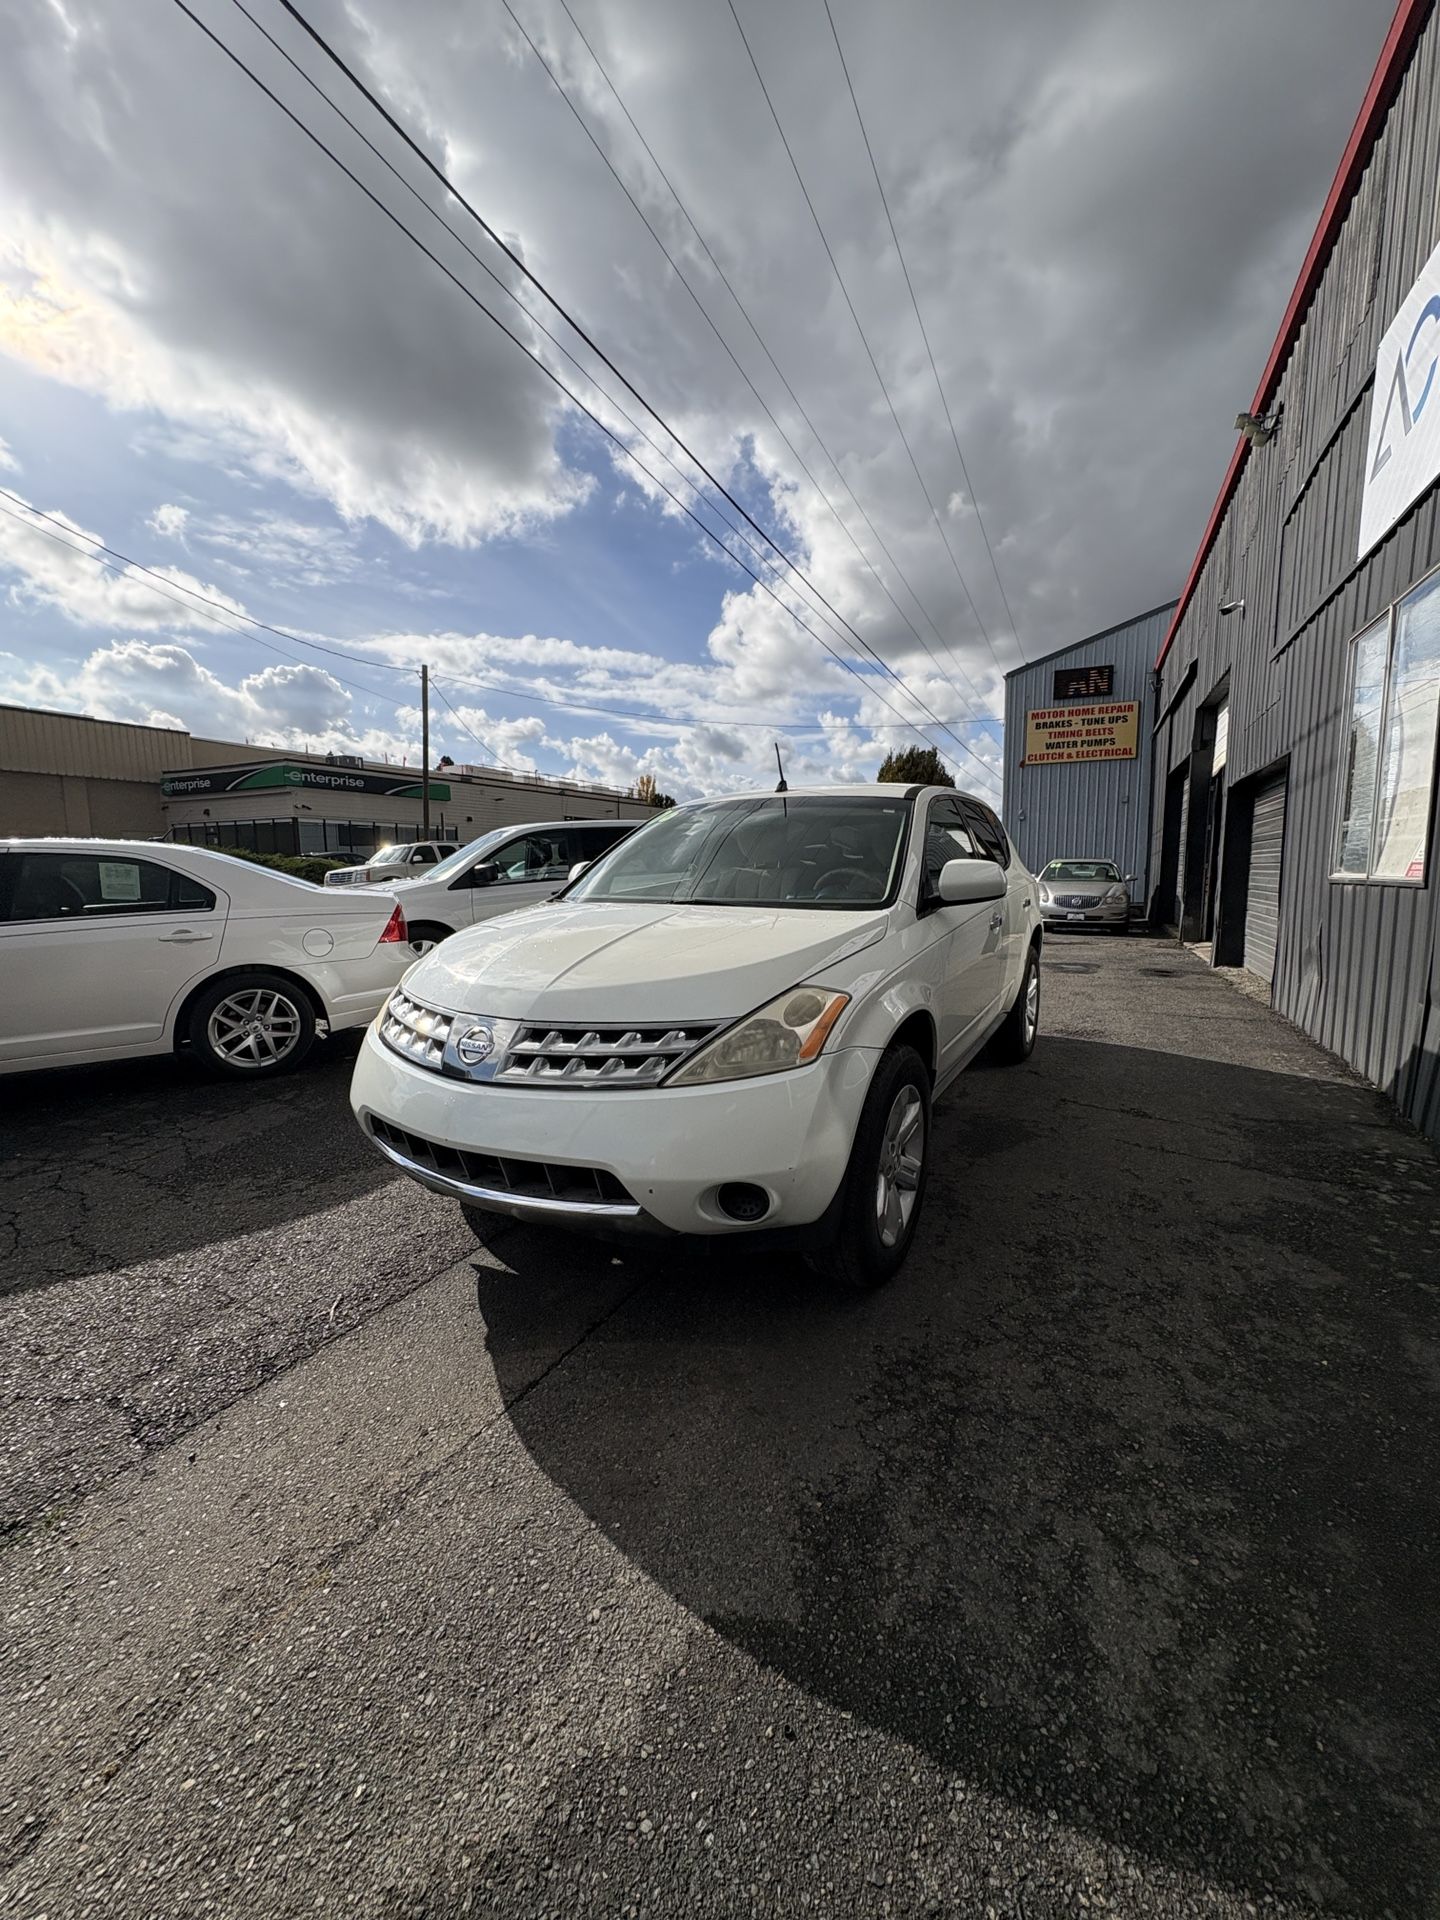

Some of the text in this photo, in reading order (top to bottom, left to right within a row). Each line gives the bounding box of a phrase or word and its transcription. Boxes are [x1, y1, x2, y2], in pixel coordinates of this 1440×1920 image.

[1031, 704, 1134, 720] MOTOR HOME REPAIR
[1035, 719, 1073, 730] BRAKES
[1081, 717, 1106, 726] TUNE
[1108, 715, 1129, 724] UPS
[1048, 727, 1114, 740] TIMING BELTS
[1045, 738, 1116, 750] WATER PUMPS
[1027, 752, 1064, 762] CLUTCH
[1076, 747, 1134, 759] ELECTRICAL
[162, 778, 211, 791] enterprise
[285, 770, 365, 787] enterprise
[461, 1040, 489, 1051] NISSAN
